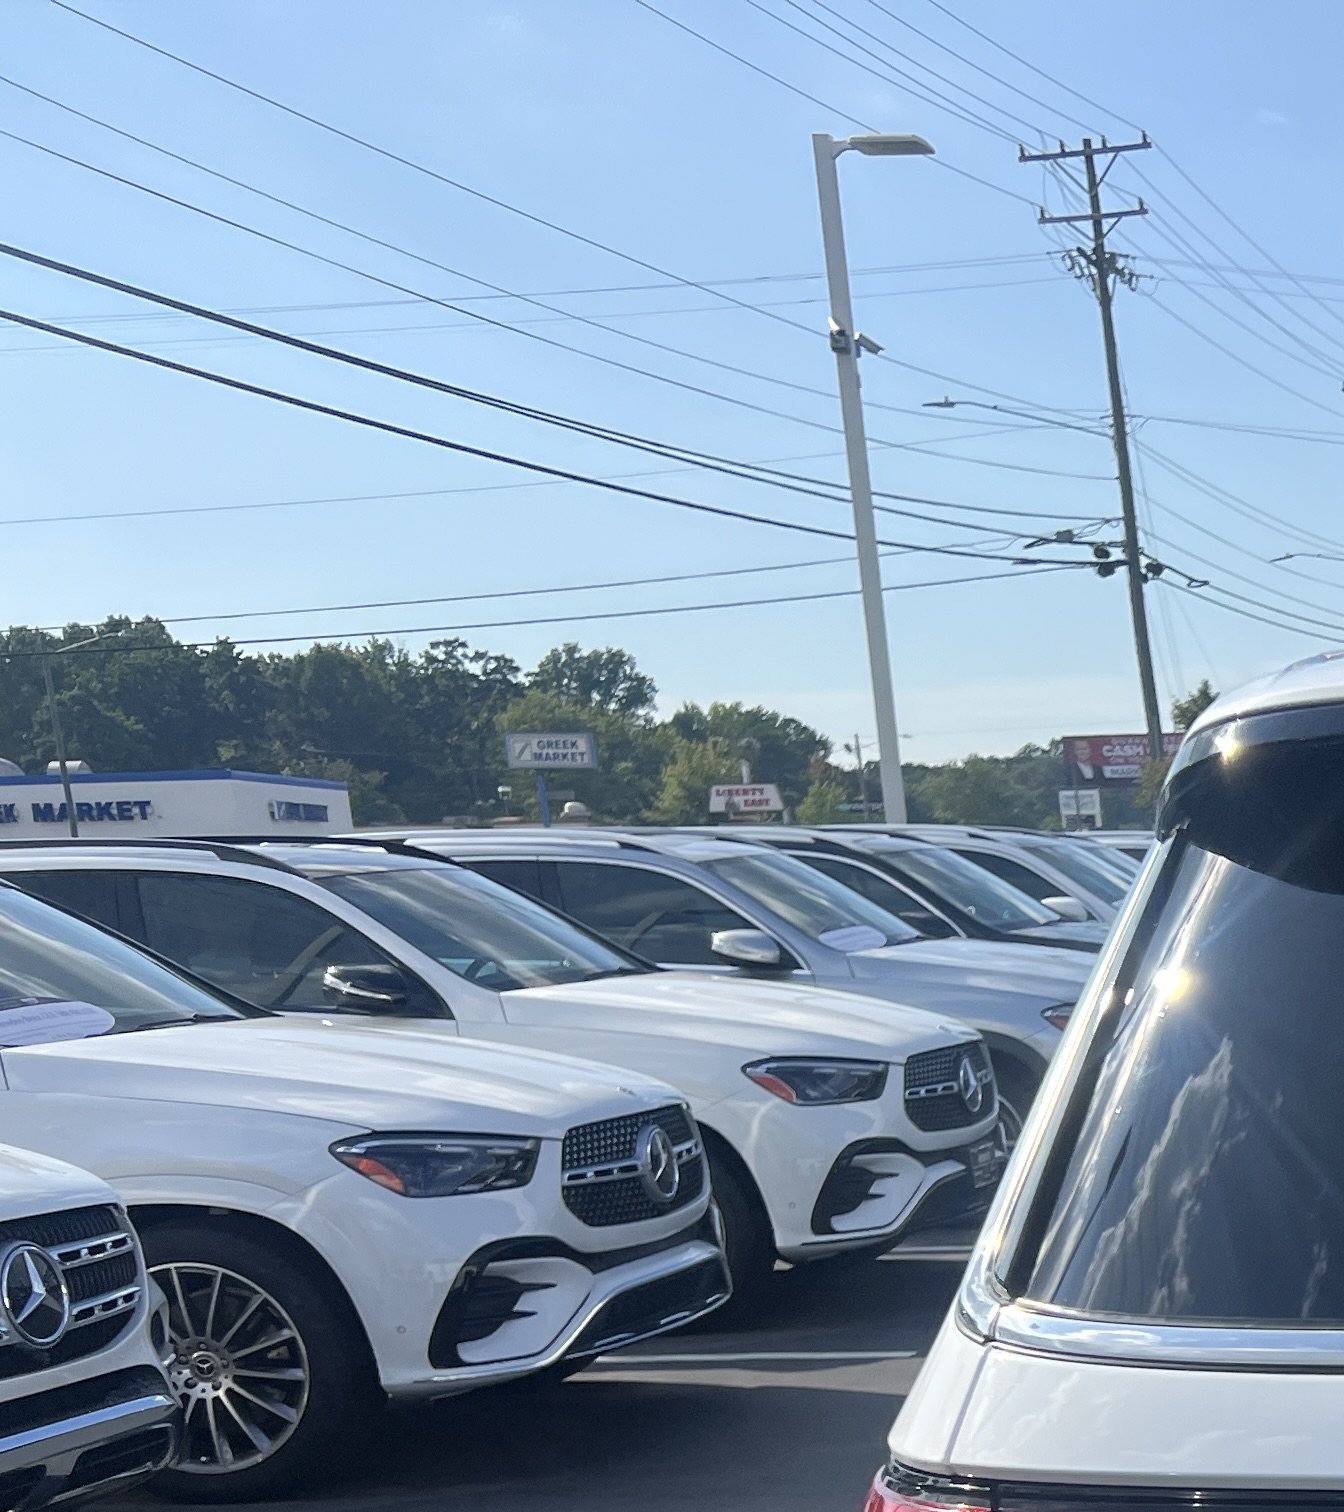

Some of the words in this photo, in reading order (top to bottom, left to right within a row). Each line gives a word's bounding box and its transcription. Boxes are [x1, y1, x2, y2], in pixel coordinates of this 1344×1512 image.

[537, 740, 578, 751] GREEK
[532, 752, 587, 762] MARKET
[31, 800, 152, 823] MARKET
